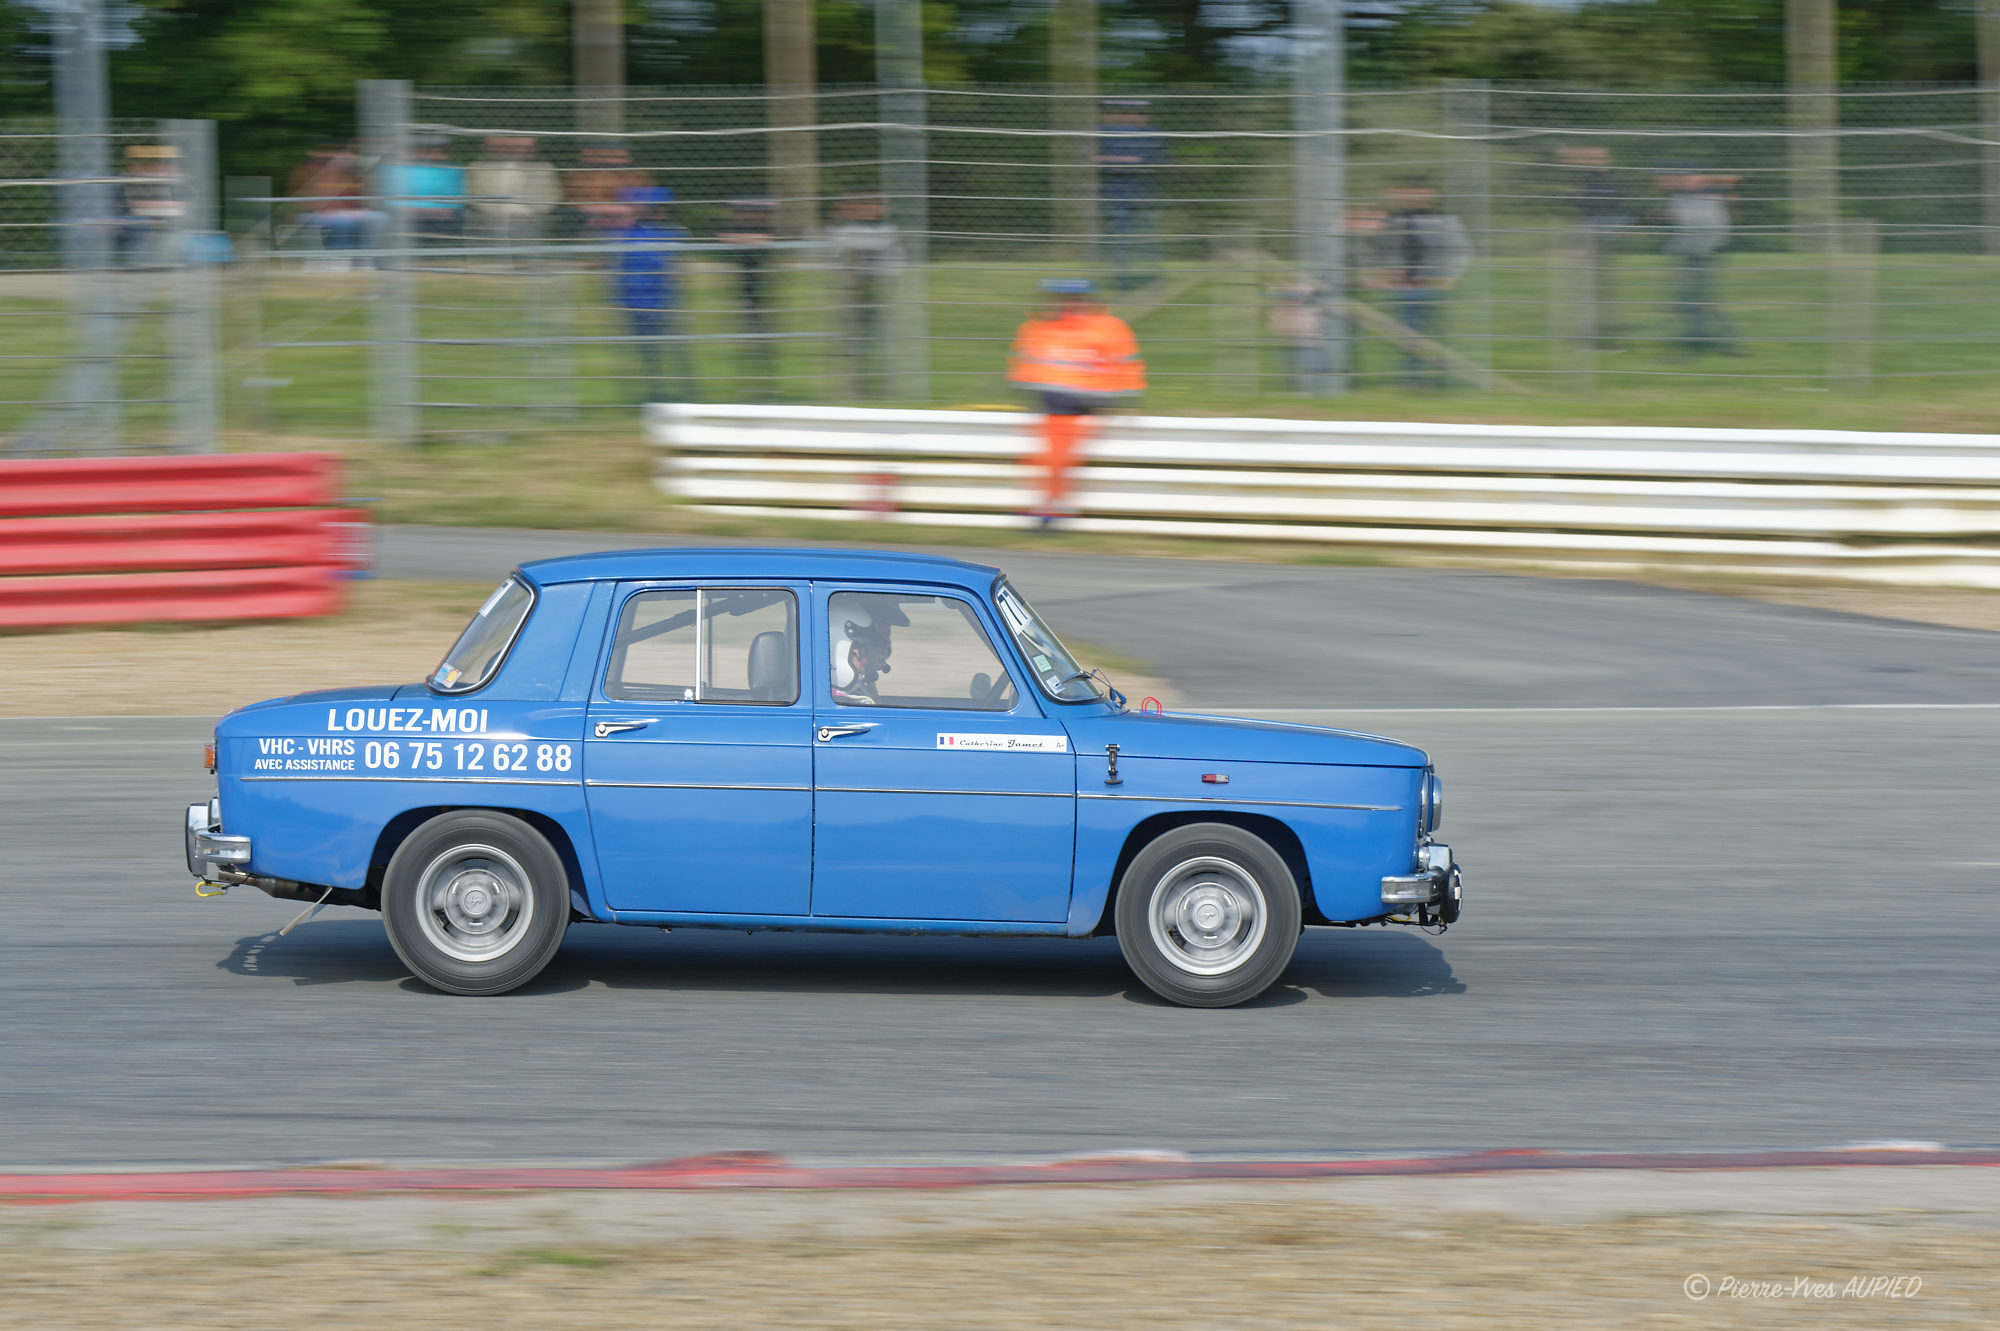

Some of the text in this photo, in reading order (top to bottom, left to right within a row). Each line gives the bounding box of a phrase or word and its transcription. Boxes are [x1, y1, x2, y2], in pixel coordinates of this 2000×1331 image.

[327, 708, 488, 733] LOUEZ-MOI
[259, 738, 294, 756] VHC
[307, 738, 355, 756] VHRS
[364, 741, 572, 772] 06 75 12 62 88
[254, 759, 355, 771] AVEC ASSISTANCE
